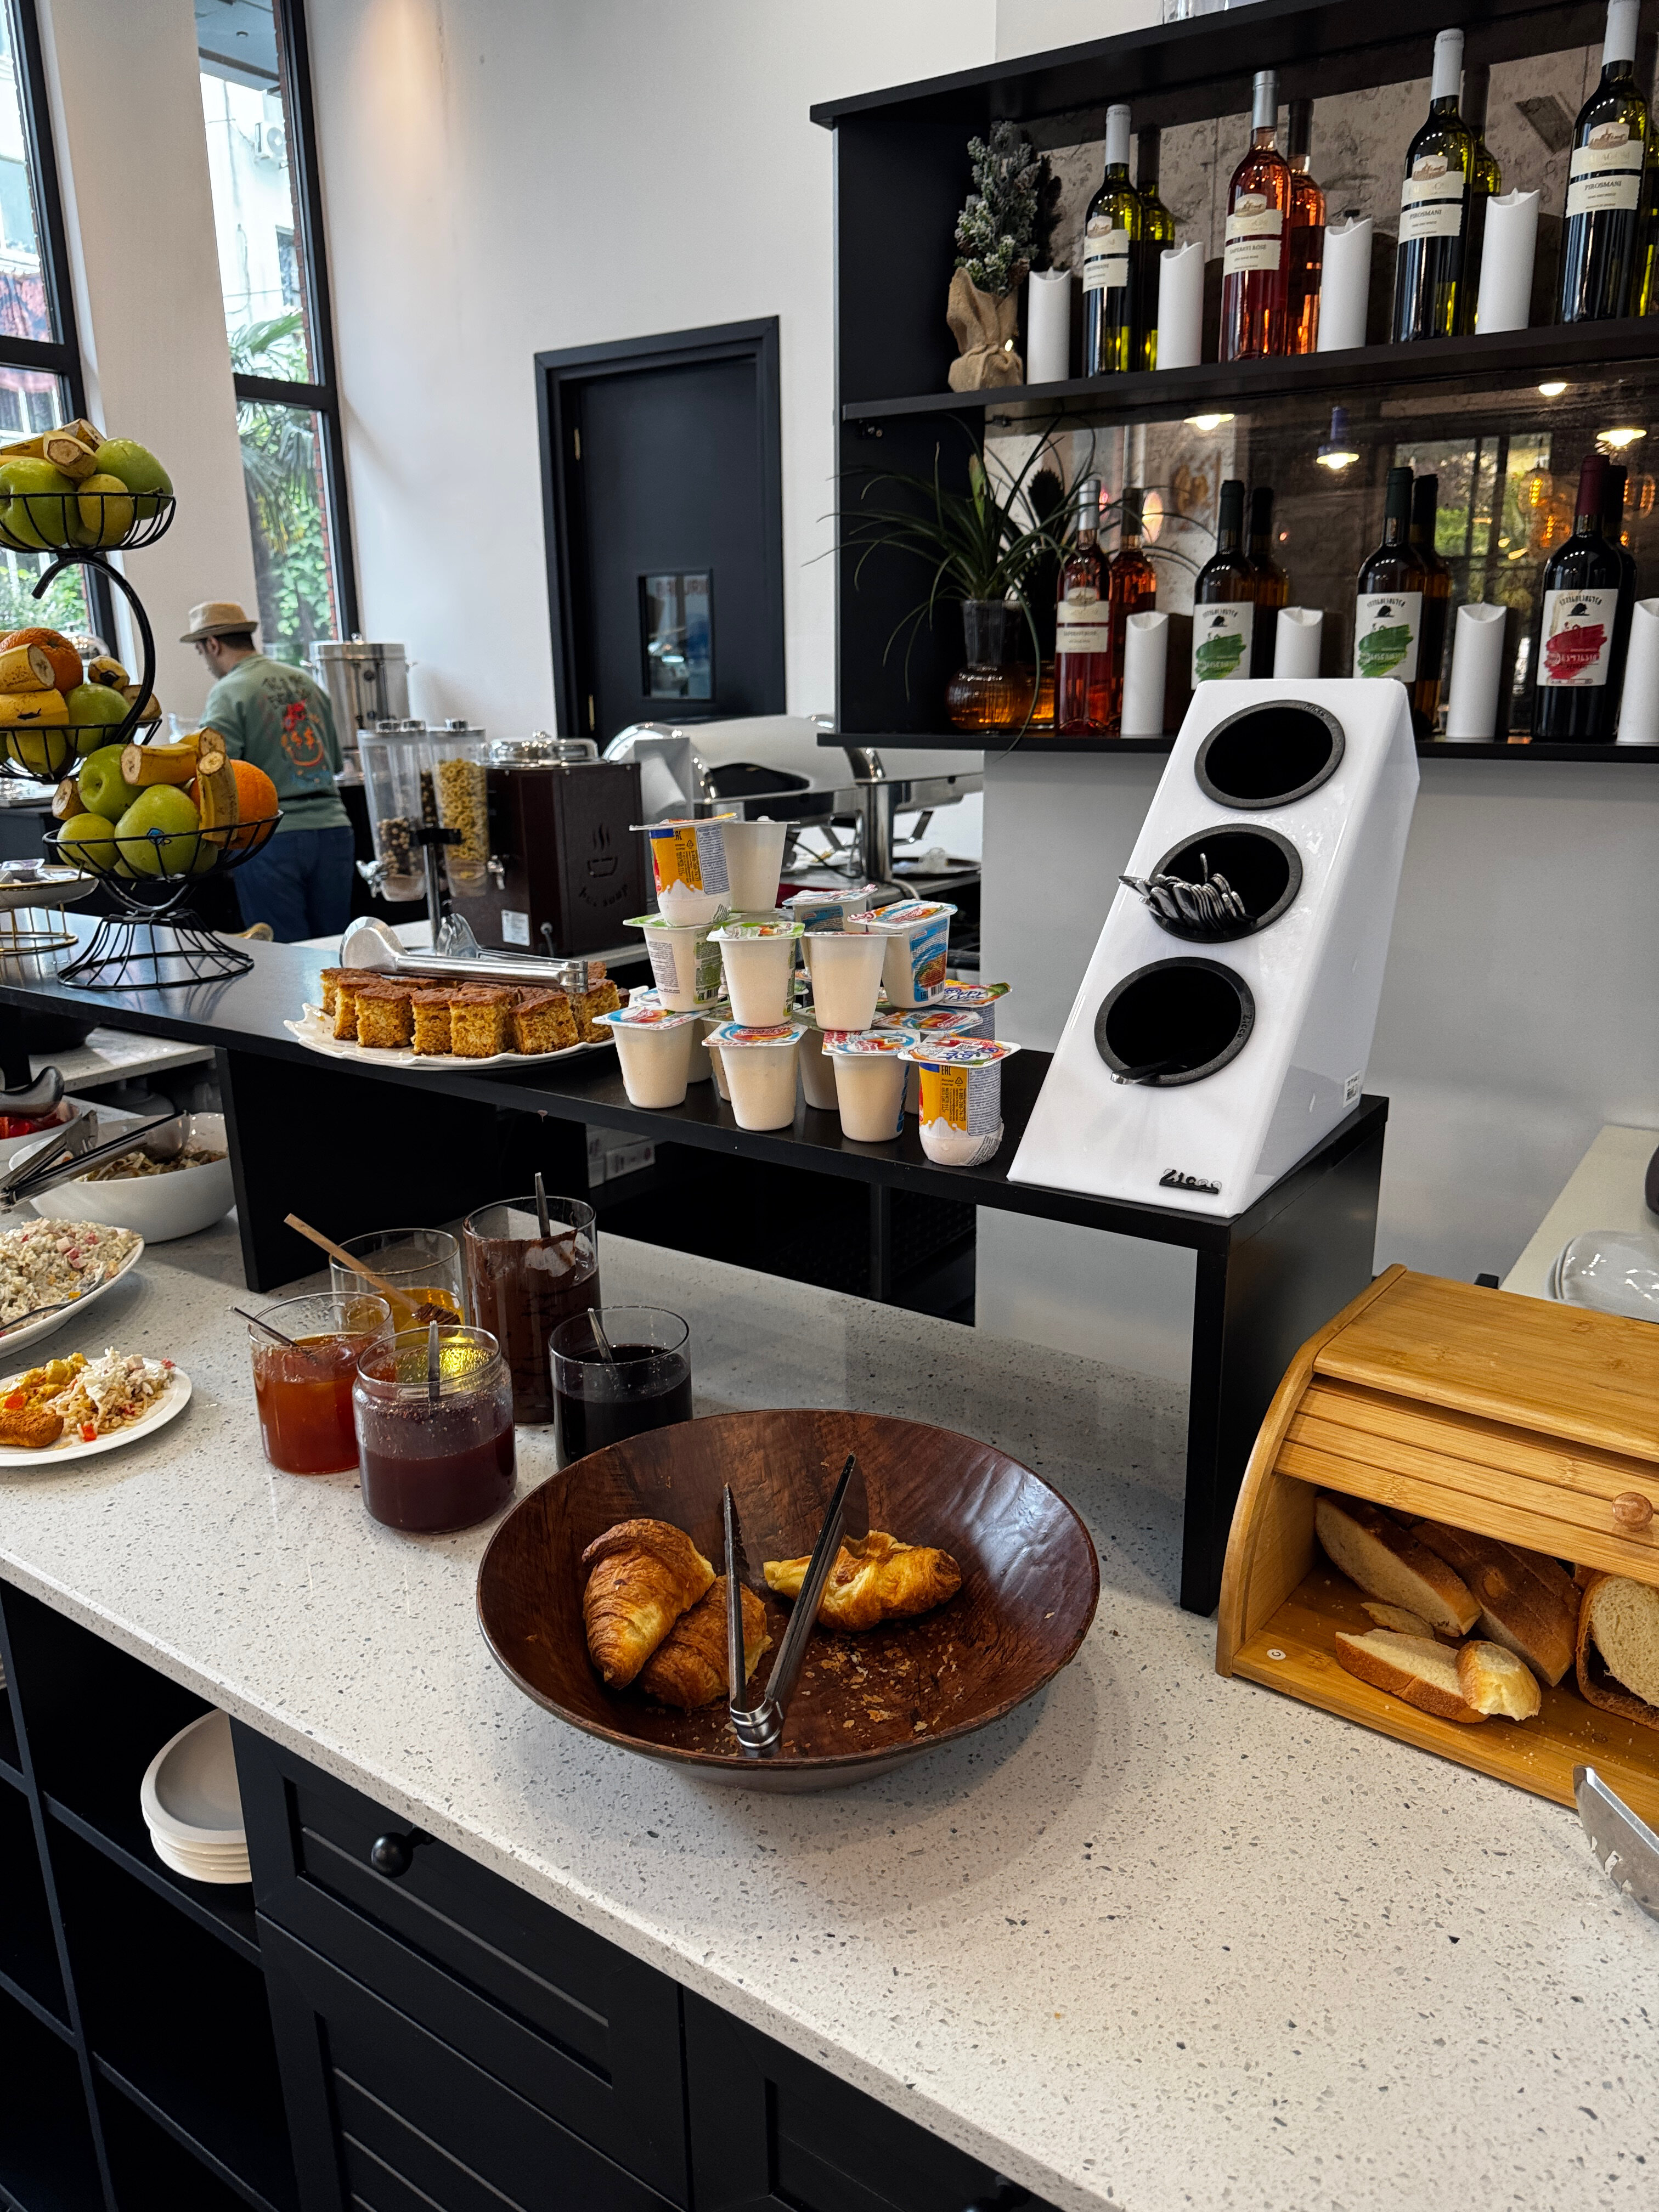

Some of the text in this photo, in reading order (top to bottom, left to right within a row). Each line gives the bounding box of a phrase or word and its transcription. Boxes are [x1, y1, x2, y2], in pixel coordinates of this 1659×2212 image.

[1584, 180, 1622, 190] PIROSMANI
[1409, 209, 1442, 219] PIROSMANI
[1237, 1014, 1253, 1038] Zicco
[941, 1065, 952, 1076] EAC
